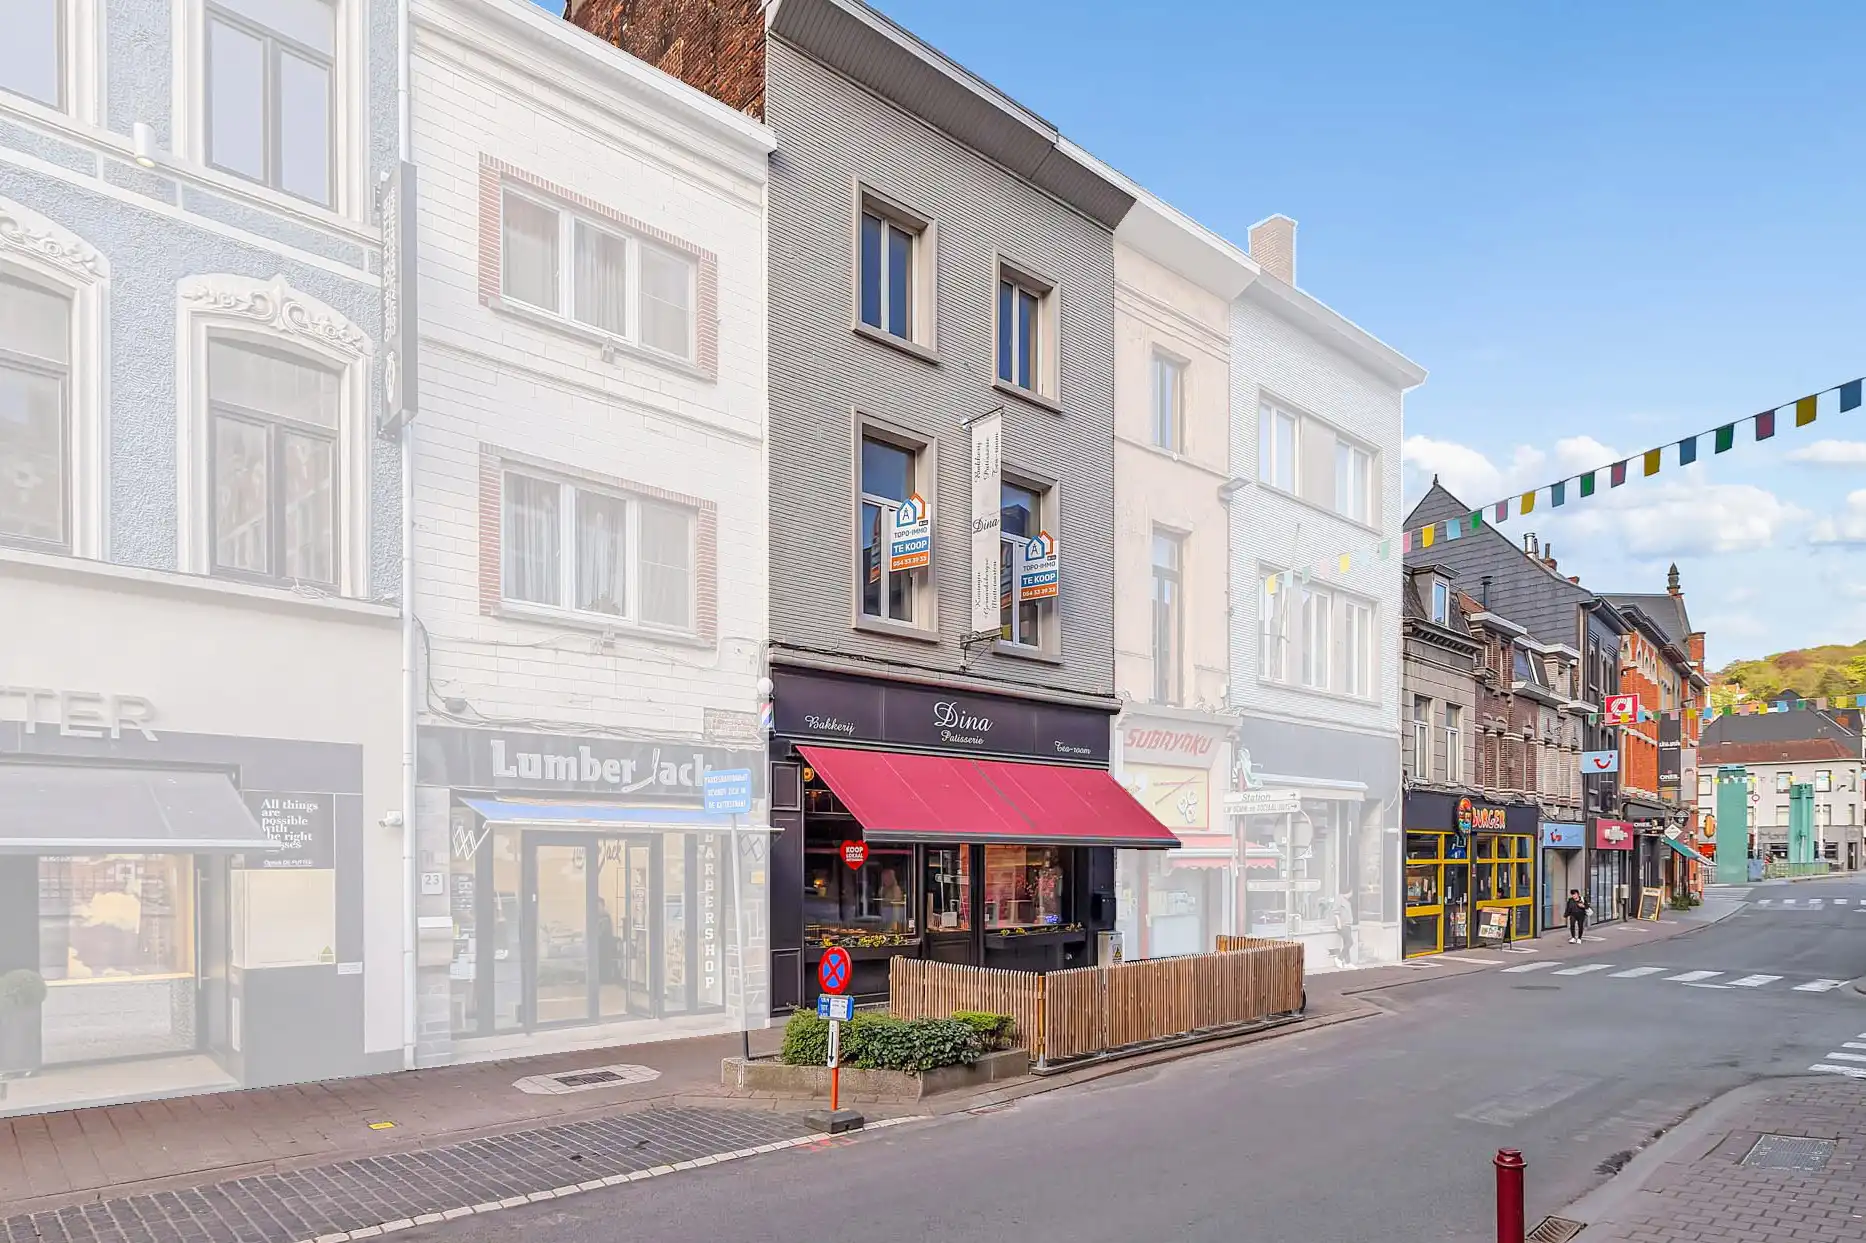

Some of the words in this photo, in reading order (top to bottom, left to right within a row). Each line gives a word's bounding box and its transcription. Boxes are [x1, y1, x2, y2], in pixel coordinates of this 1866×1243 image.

[893, 526, 928, 539] TOPO-IMMO
[972, 516, 999, 535] Dina
[893, 544, 904, 553] TE
[905, 540, 927, 552] KOOP
[1023, 561, 1055, 572] TOPO-IMMO
[1023, 576, 1033, 585] TE
[1034, 573, 1055, 583] KOOP
[0, 684, 159, 742] TER
[933, 701, 994, 733] Dina
[804, 714, 856, 736] Bakkerij
[940, 730, 985, 746] Patisserie
[491, 739, 637, 784] Lumber
[1242, 791, 1271, 802] Station
[261, 798, 279, 809] All
[282, 799, 319, 813] things
[261, 808, 281, 817] are
[261, 815, 308, 829] possible
[284, 831, 312, 843] right
[425, 873, 440, 886] 23
[704, 832, 715, 989] BARBERSHOP
